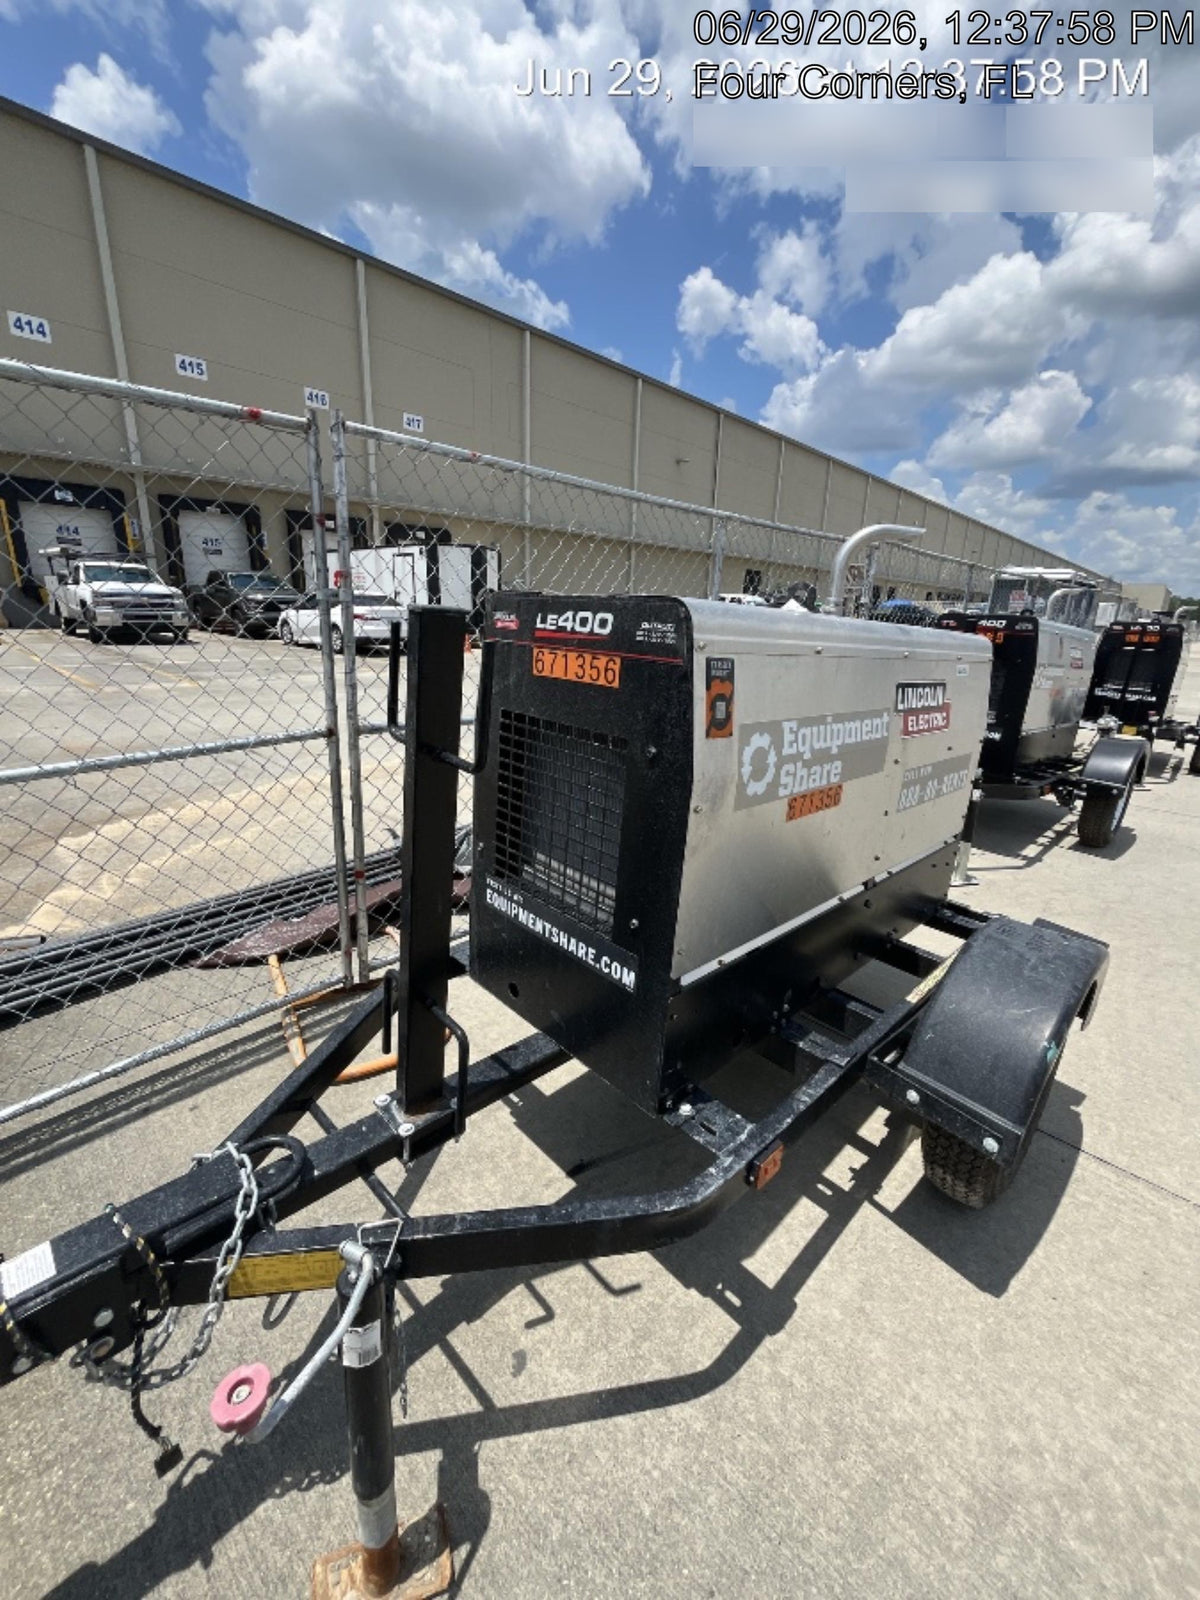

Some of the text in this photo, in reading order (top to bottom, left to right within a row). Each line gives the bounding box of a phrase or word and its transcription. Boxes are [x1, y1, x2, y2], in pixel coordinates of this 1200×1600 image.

[13, 316, 47, 338] 414
[178, 358, 205, 377] 415
[306, 390, 328, 407] 416
[56, 524, 80, 536] 414
[535, 610, 615, 636] LE400
[534, 649, 618, 686] 671356
[897, 685, 944, 711] LINCOLN
[907, 711, 948, 732] ELECTRIC
[781, 711, 891, 760] Equipment
[777, 759, 843, 797] Share
[486, 888, 637, 990] EQUIPMENTSHARE.COM
